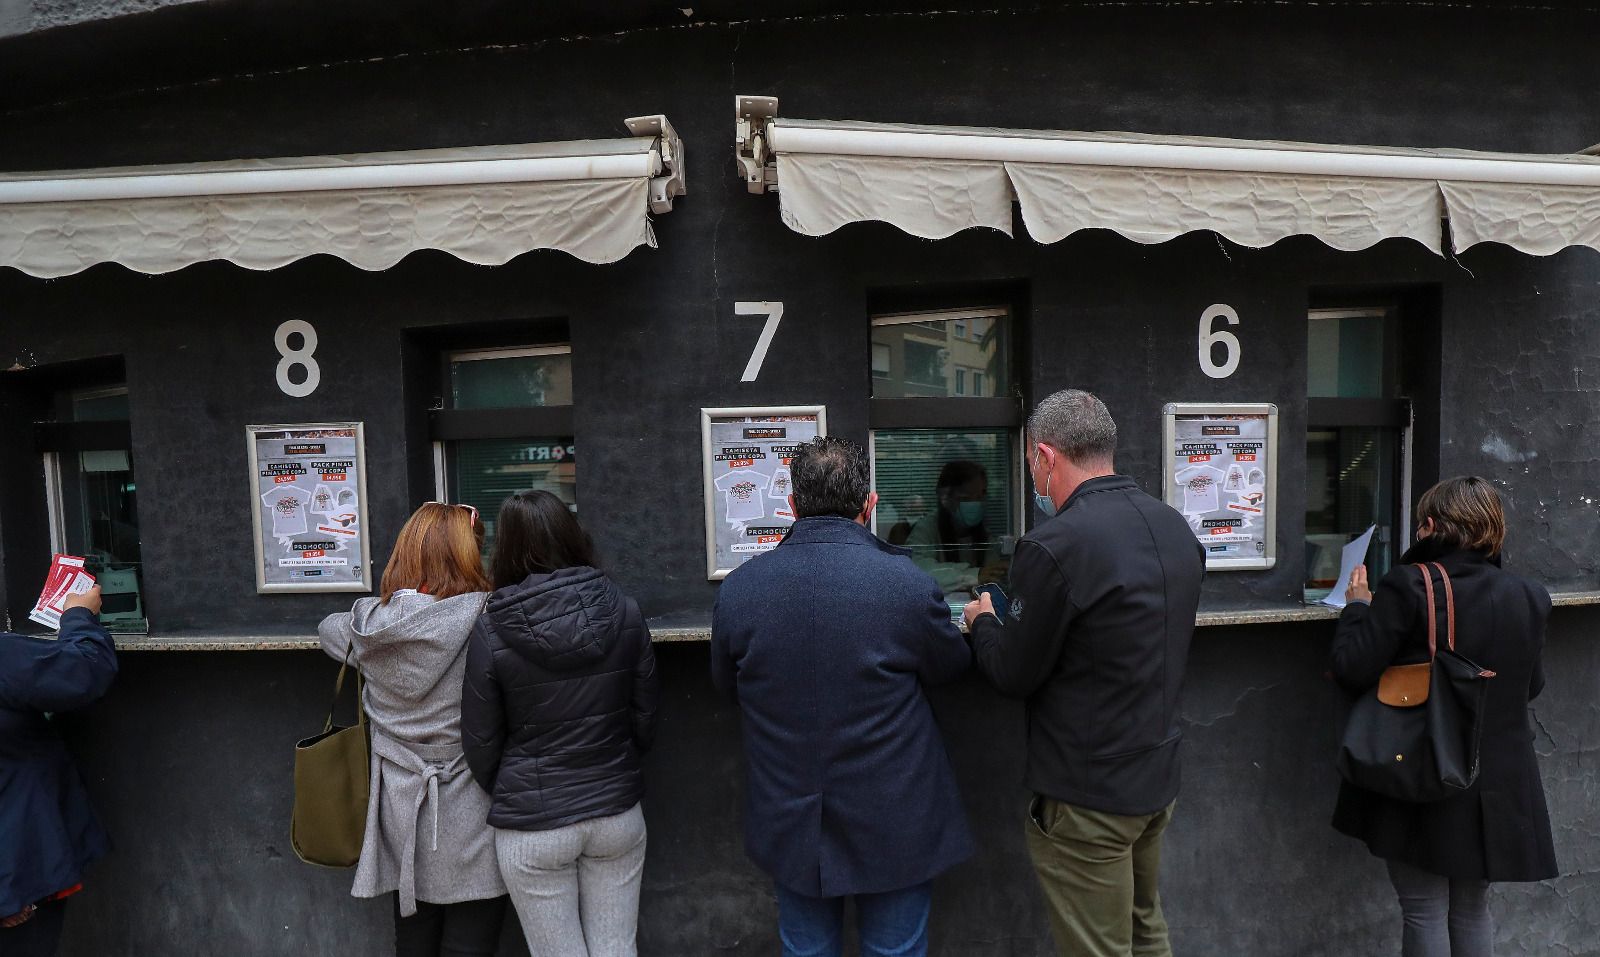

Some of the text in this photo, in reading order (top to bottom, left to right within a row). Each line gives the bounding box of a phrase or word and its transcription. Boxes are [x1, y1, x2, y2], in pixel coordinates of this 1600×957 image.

[274, 320, 320, 397] 8
[735, 301, 783, 382] 7
[1198, 304, 1241, 378] 6
[294, 542, 334, 550] PROMOCIÓN
